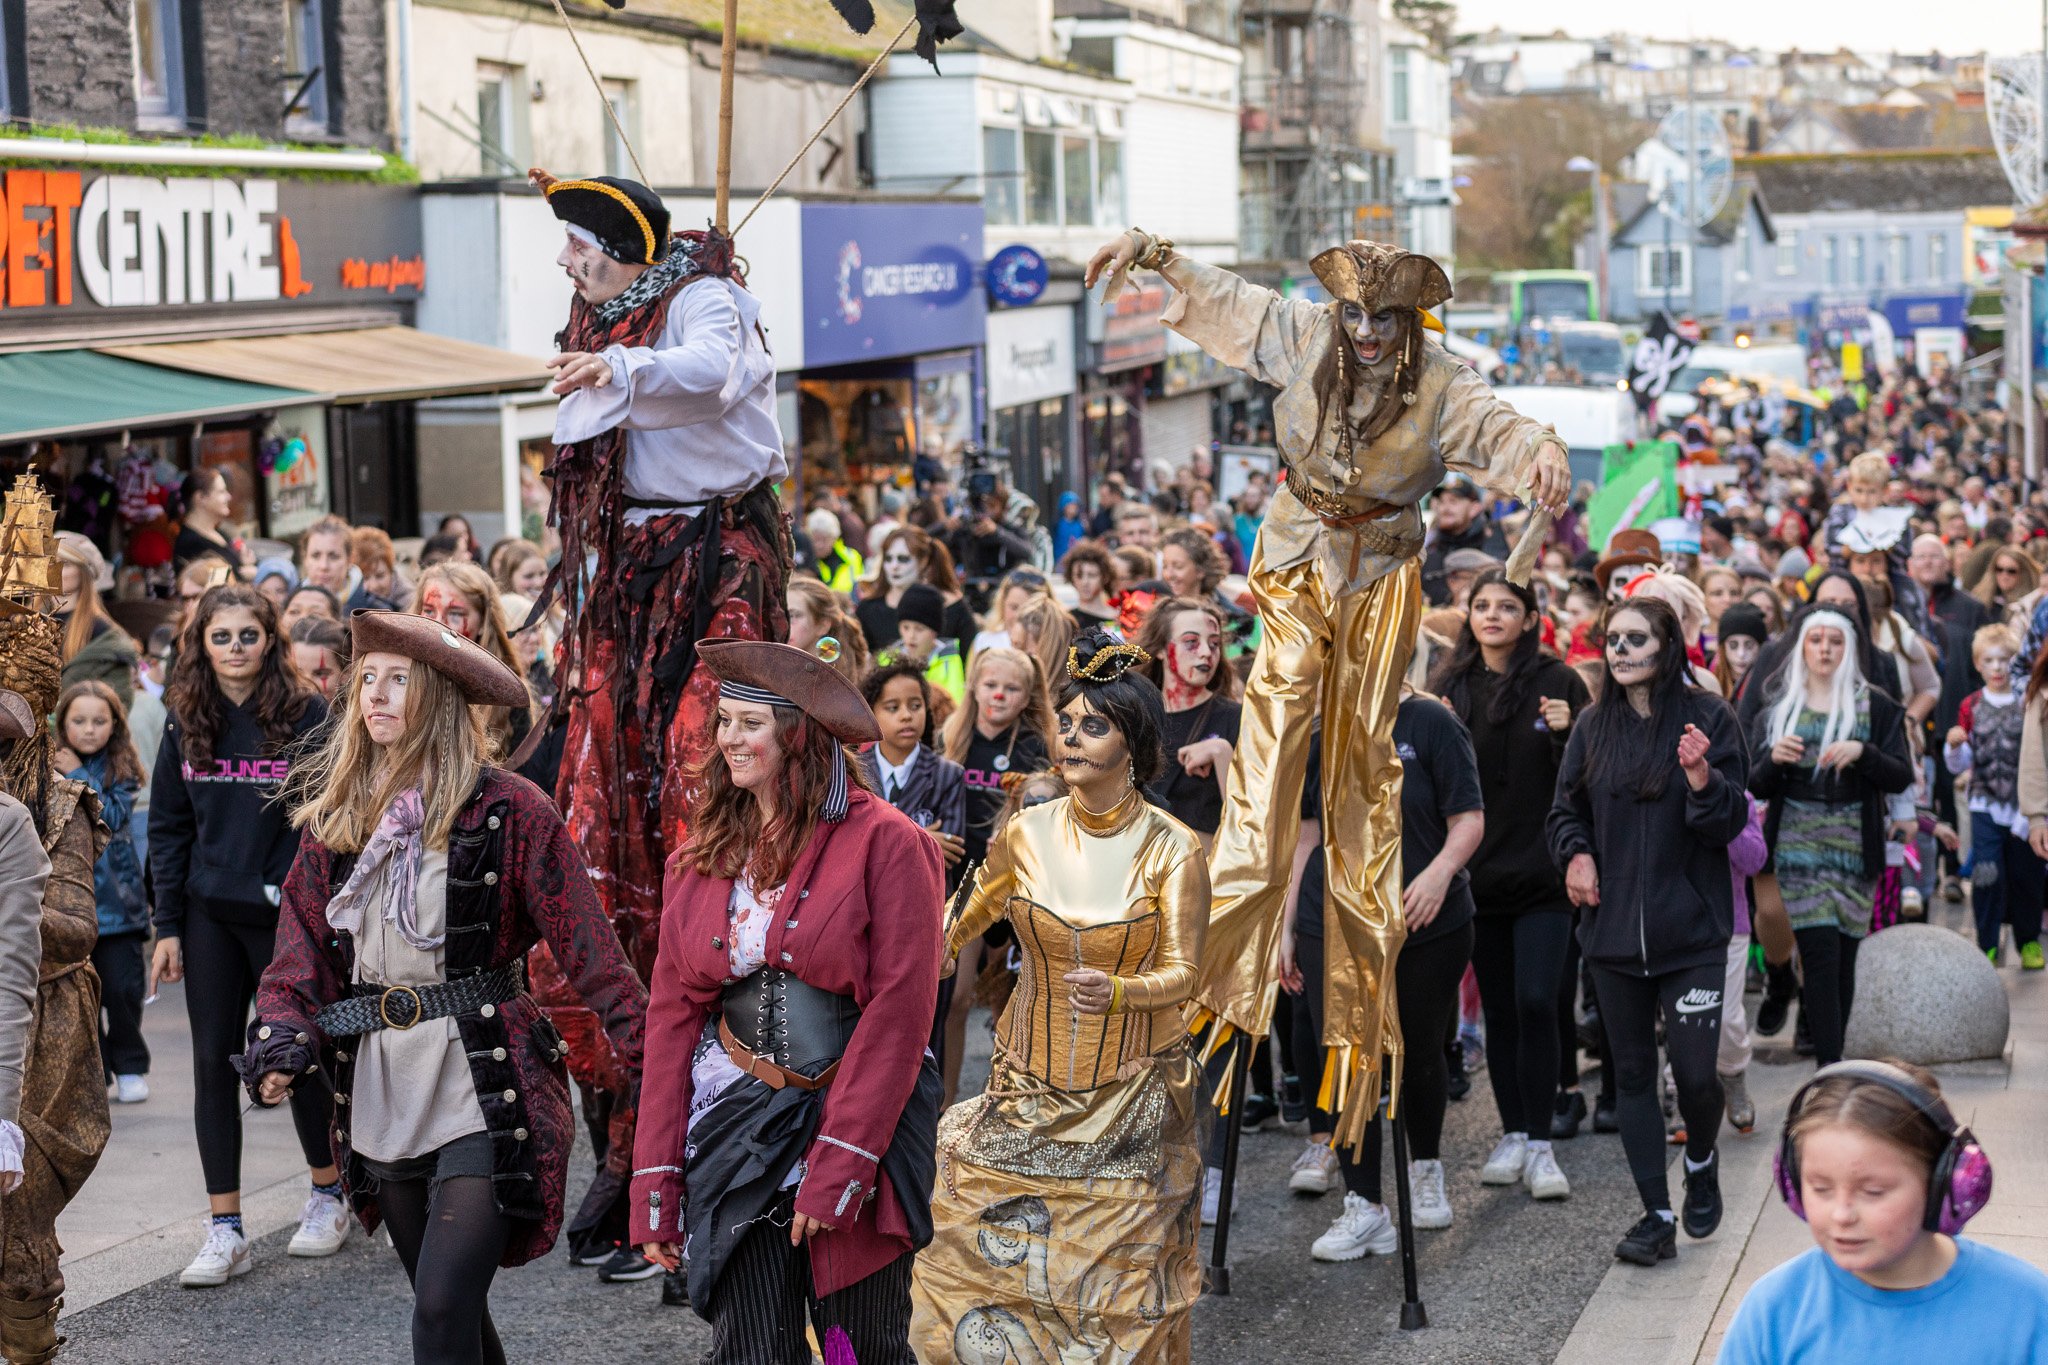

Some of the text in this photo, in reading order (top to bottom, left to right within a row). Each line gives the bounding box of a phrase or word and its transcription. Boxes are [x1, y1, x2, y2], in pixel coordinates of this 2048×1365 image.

[0, 170, 280, 309] ET CENTRE
[194, 759, 288, 778] OUNCE
[236, 776, 284, 784] academ
[1685, 988, 1720, 1004] NIKE
[1680, 1015, 1716, 1028] AIR
